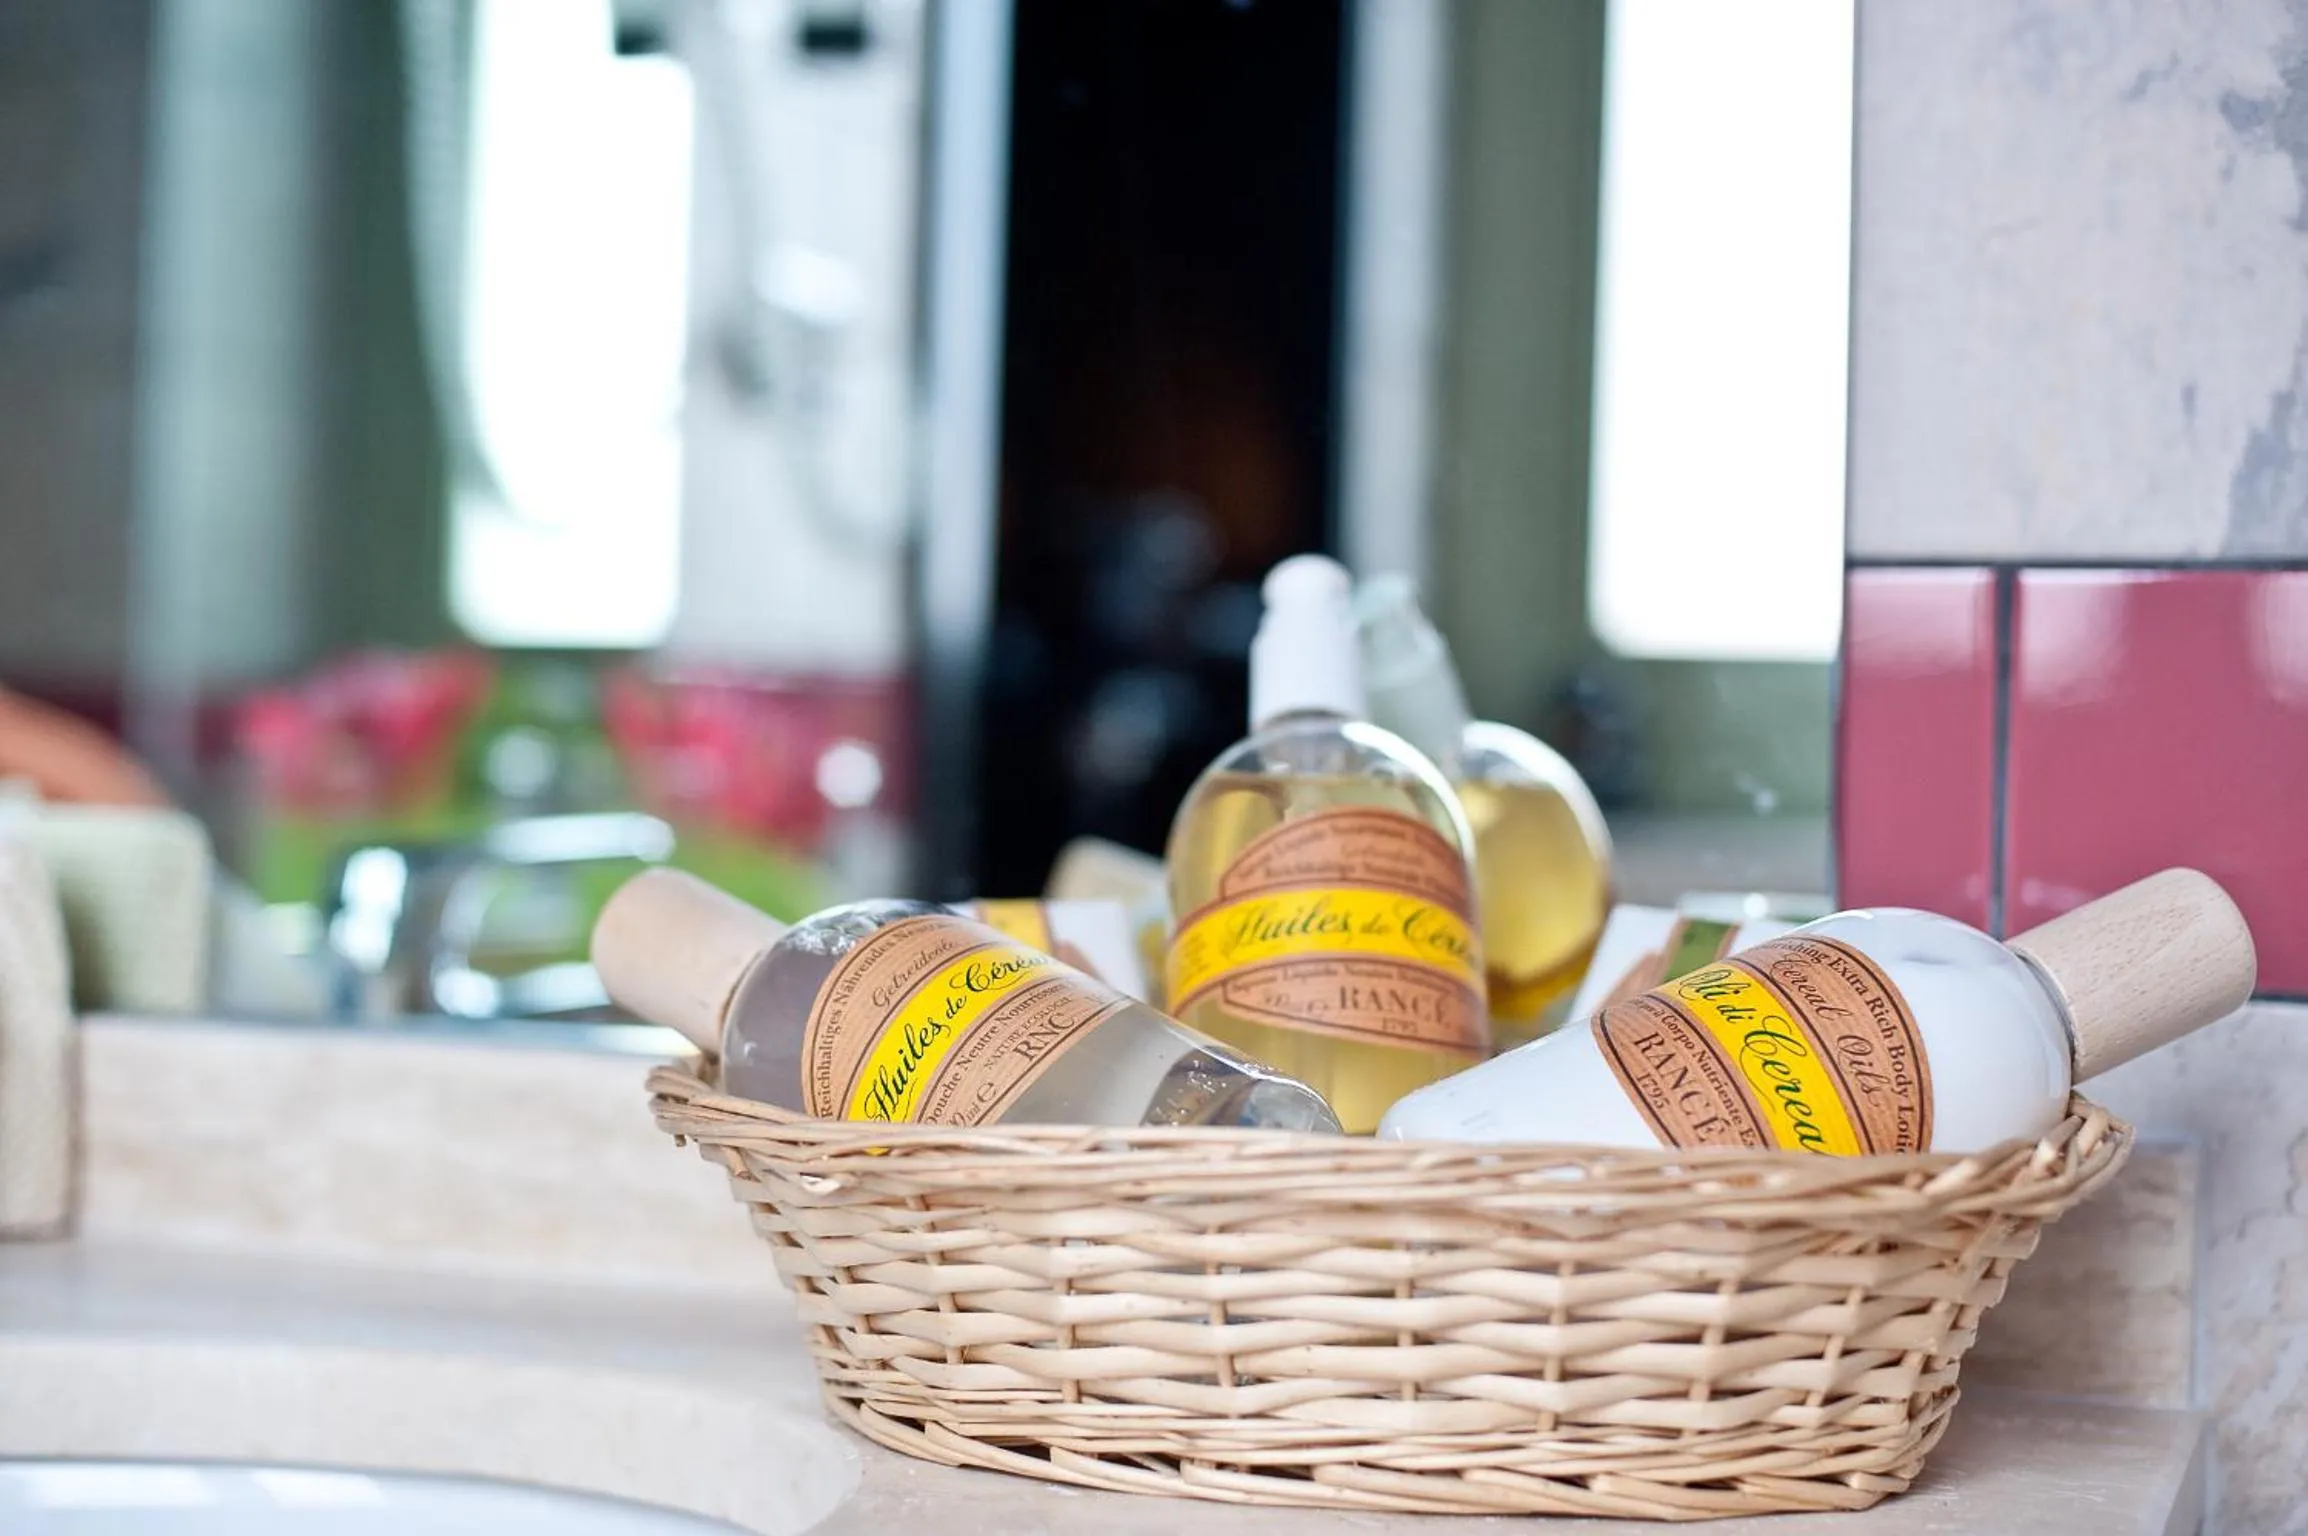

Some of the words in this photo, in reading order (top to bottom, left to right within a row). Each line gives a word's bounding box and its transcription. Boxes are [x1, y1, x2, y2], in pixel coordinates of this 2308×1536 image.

[817, 1009, 843, 1119] Reichhaltiges
[864, 1017, 951, 1121] Huiles
[945, 995, 967, 1019] de
[955, 1024, 1003, 1072] Neutre
[1013, 1011, 1075, 1063] RNC
[1716, 1004, 1757, 1023] di
[1770, 953, 1853, 1021] Cereal
[1837, 1035, 1881, 1107] Oils
[1827, 957, 1868, 996] Extra
[1867, 996, 1896, 1038] Rich
[1886, 1045, 1914, 1098] Body
[1634, 1031, 1732, 1142] RANCÉ
[1637, 1072, 1670, 1109] 1795
[1661, 1014, 1695, 1050] Corpo
[1692, 1048, 1743, 1126] Nutriente
